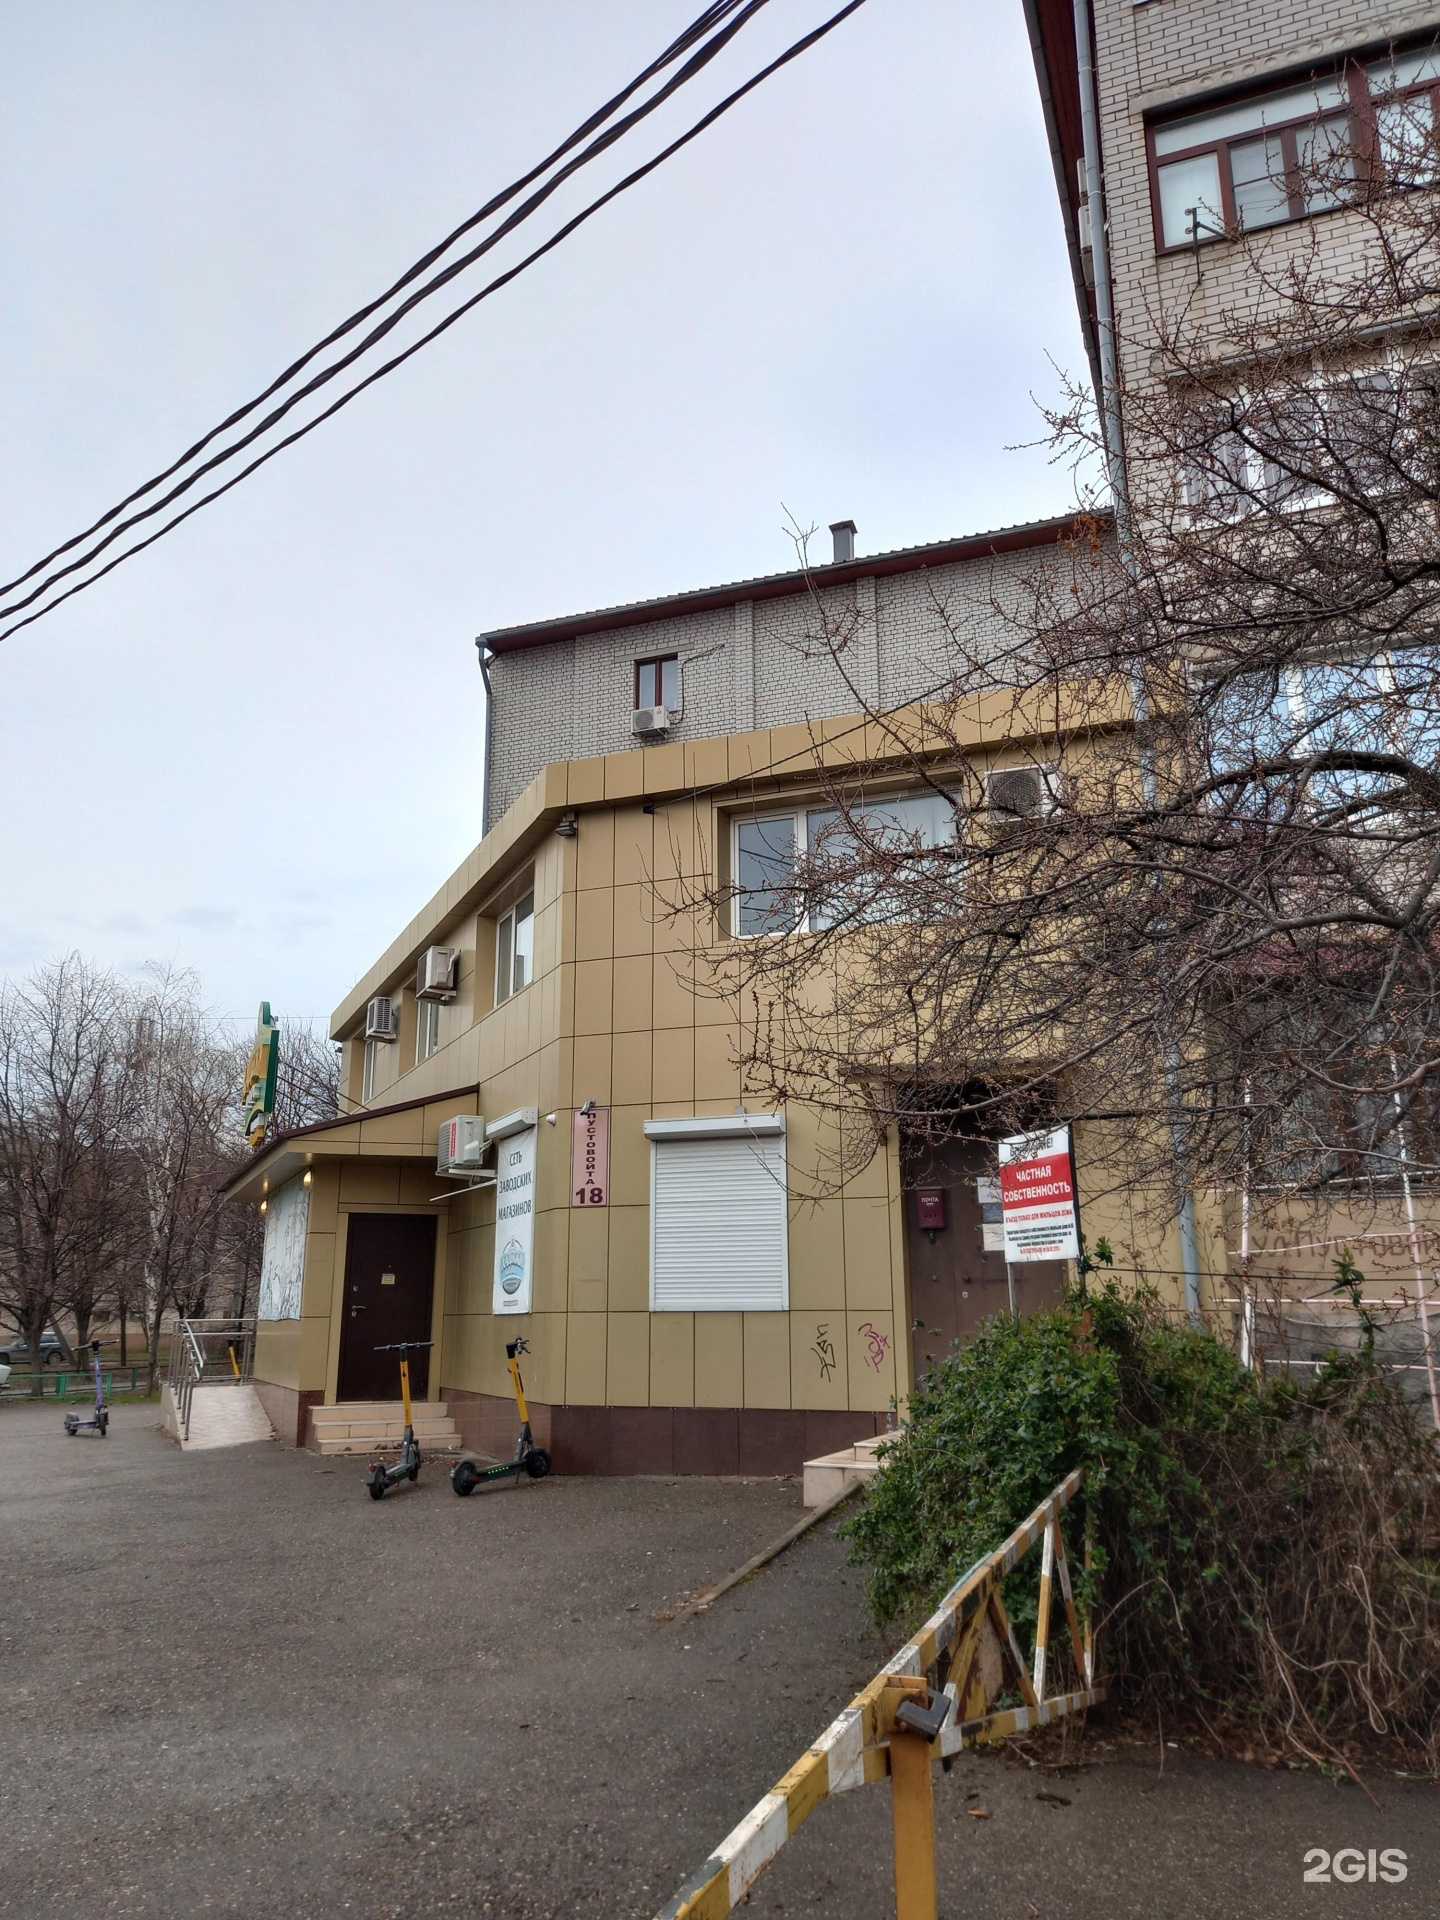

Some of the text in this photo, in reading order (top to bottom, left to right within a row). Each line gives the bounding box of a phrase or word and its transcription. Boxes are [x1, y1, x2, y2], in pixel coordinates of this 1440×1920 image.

[509, 1150, 522, 1167] СЕТЬ
[586, 1112, 596, 1185] ПУСТОВОЙТА
[499, 1171, 532, 1193] ЗАВОДСКИХ
[1016, 1165, 1052, 1182] ЧАСТНАЯ
[575, 1187, 603, 1204] 18
[1003, 1181, 1071, 1203] СОБСТВЕННОСТЬ
[498, 1199, 532, 1221] МАГАЗИНОВ
